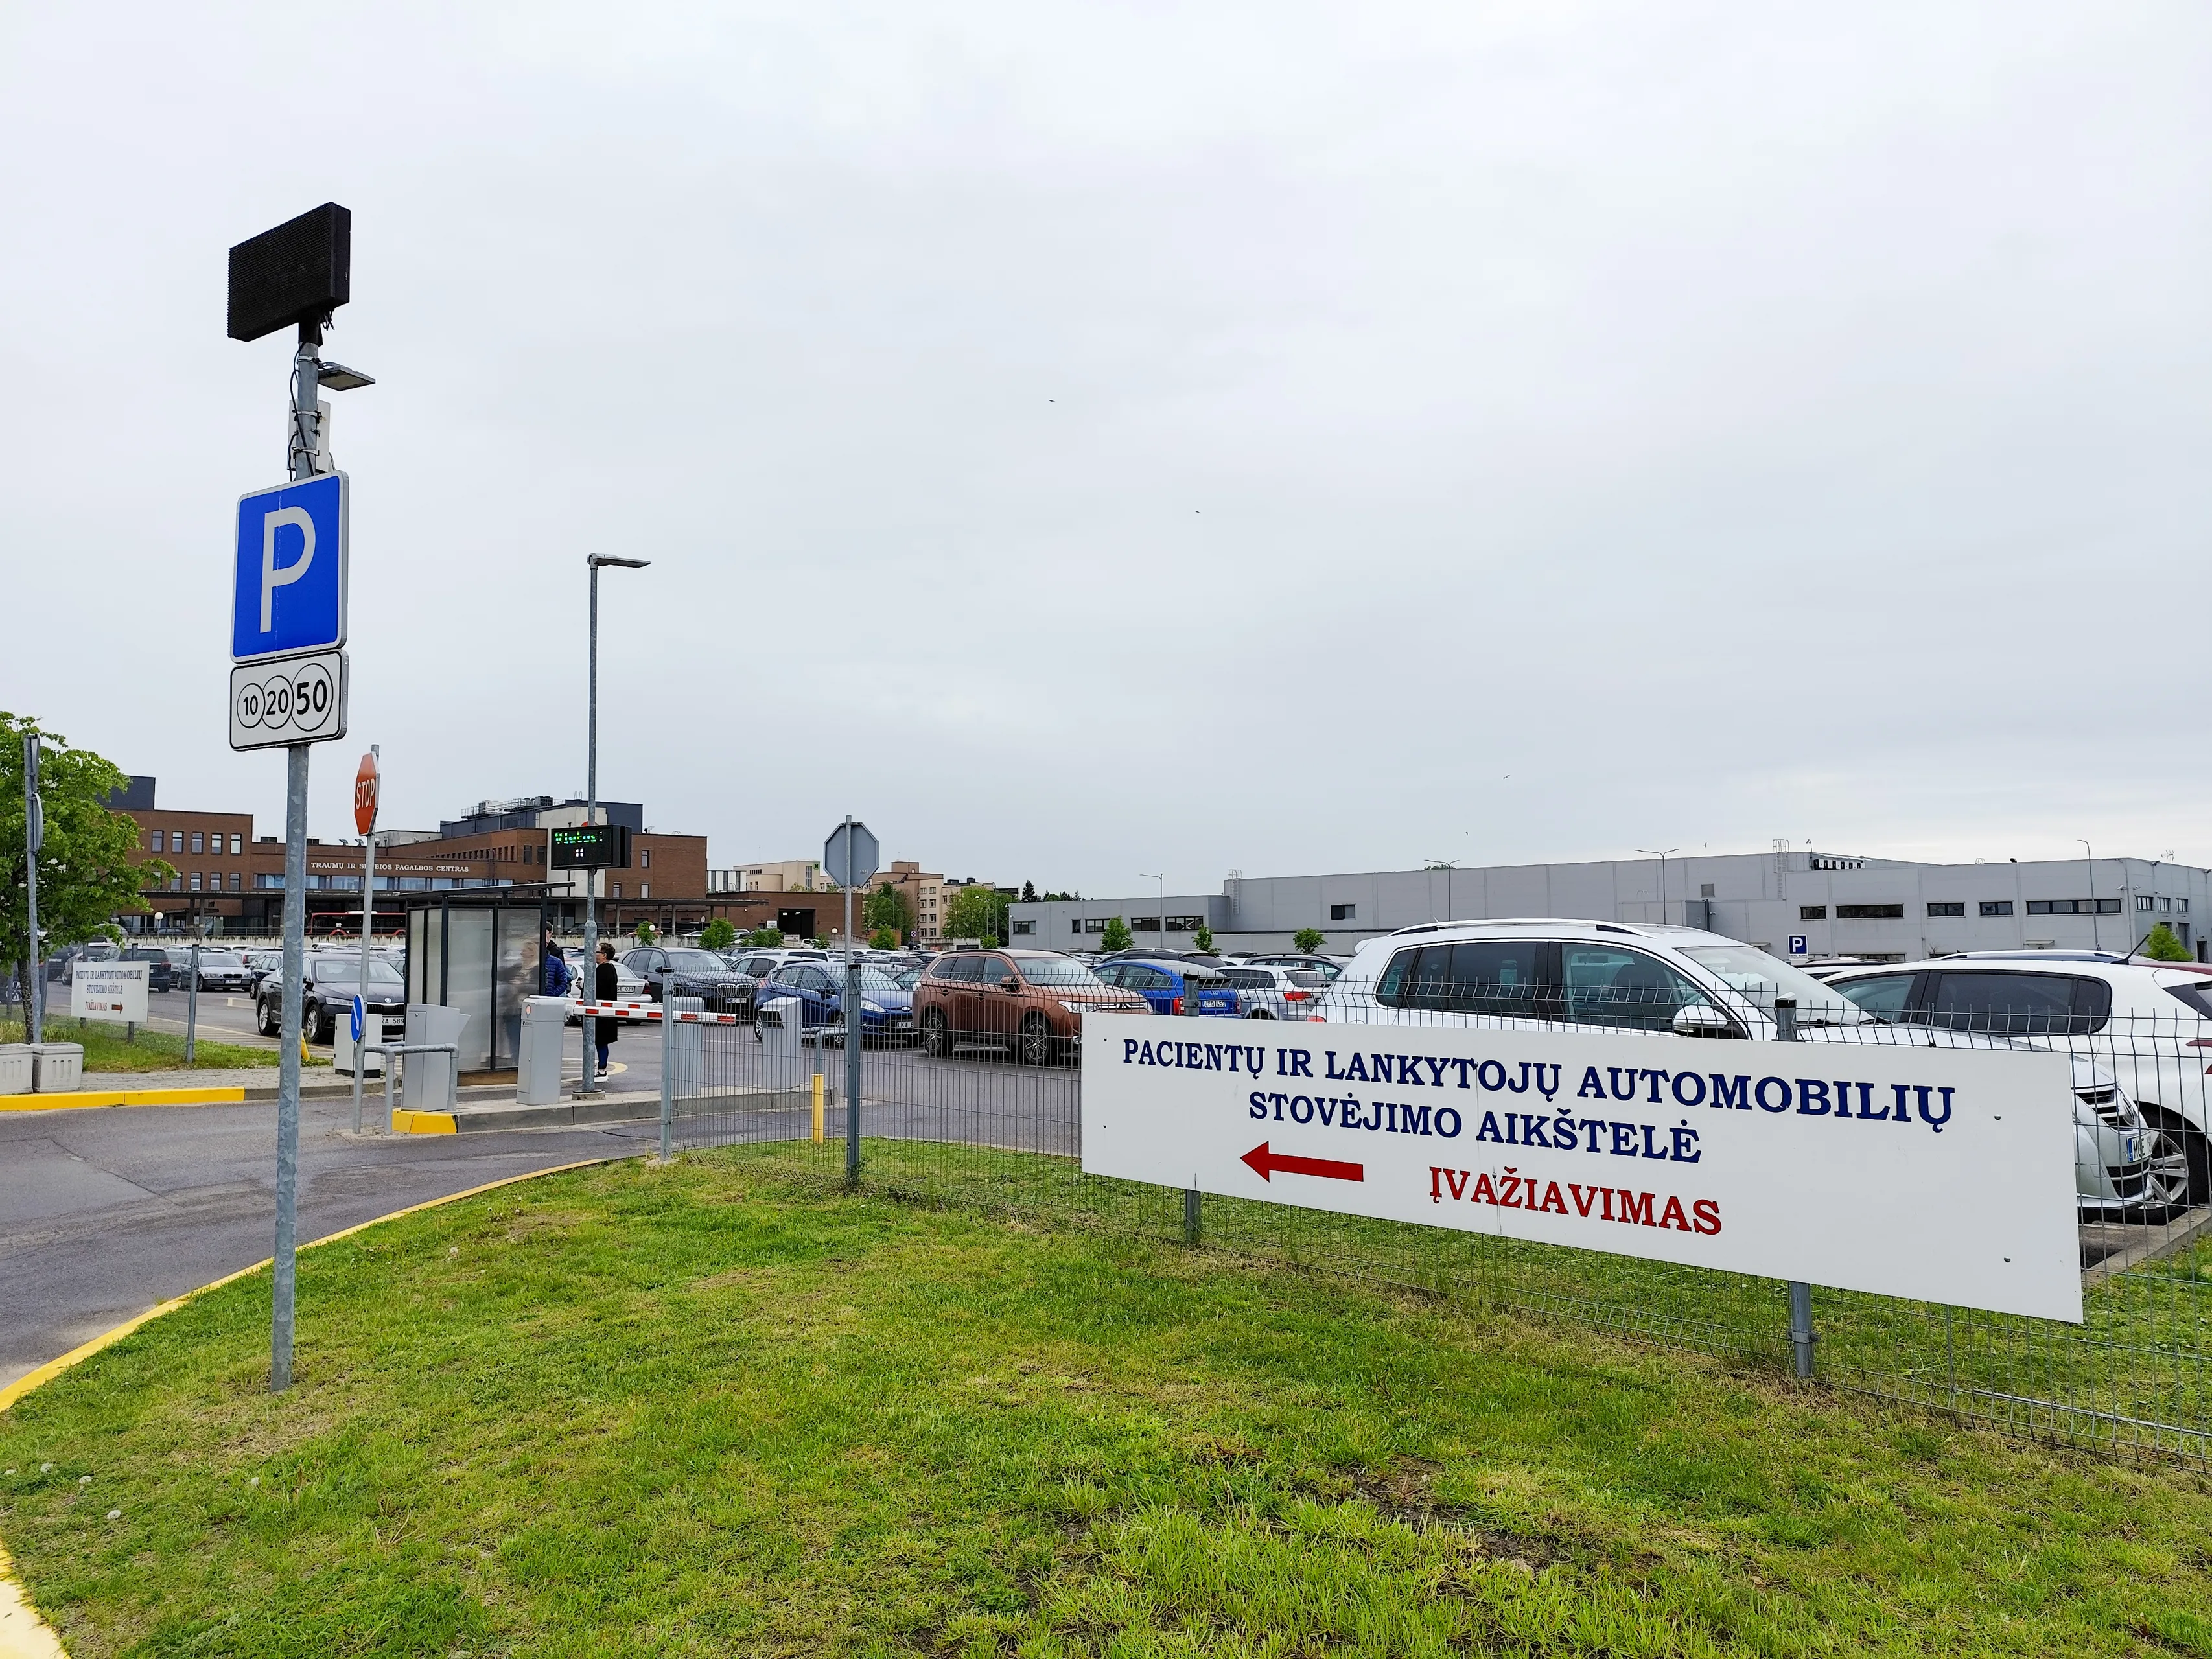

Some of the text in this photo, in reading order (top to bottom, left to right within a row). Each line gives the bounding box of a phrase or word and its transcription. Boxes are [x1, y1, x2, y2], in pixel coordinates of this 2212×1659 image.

[260, 506, 316, 634] P
[243, 679, 327, 716] 10 20 50
[356, 778, 375, 810] STOP
[1792, 937, 1803, 953] P
[1123, 1038, 1955, 1133] PACIENTŲ IR LANKYTOJŲ AUTOMOBILIŲ
[1249, 1091, 1702, 1164] STOVĖJIMO AIKŠTELĖ
[1428, 1166, 1722, 1236] ĮVAŽIAVIMAS
